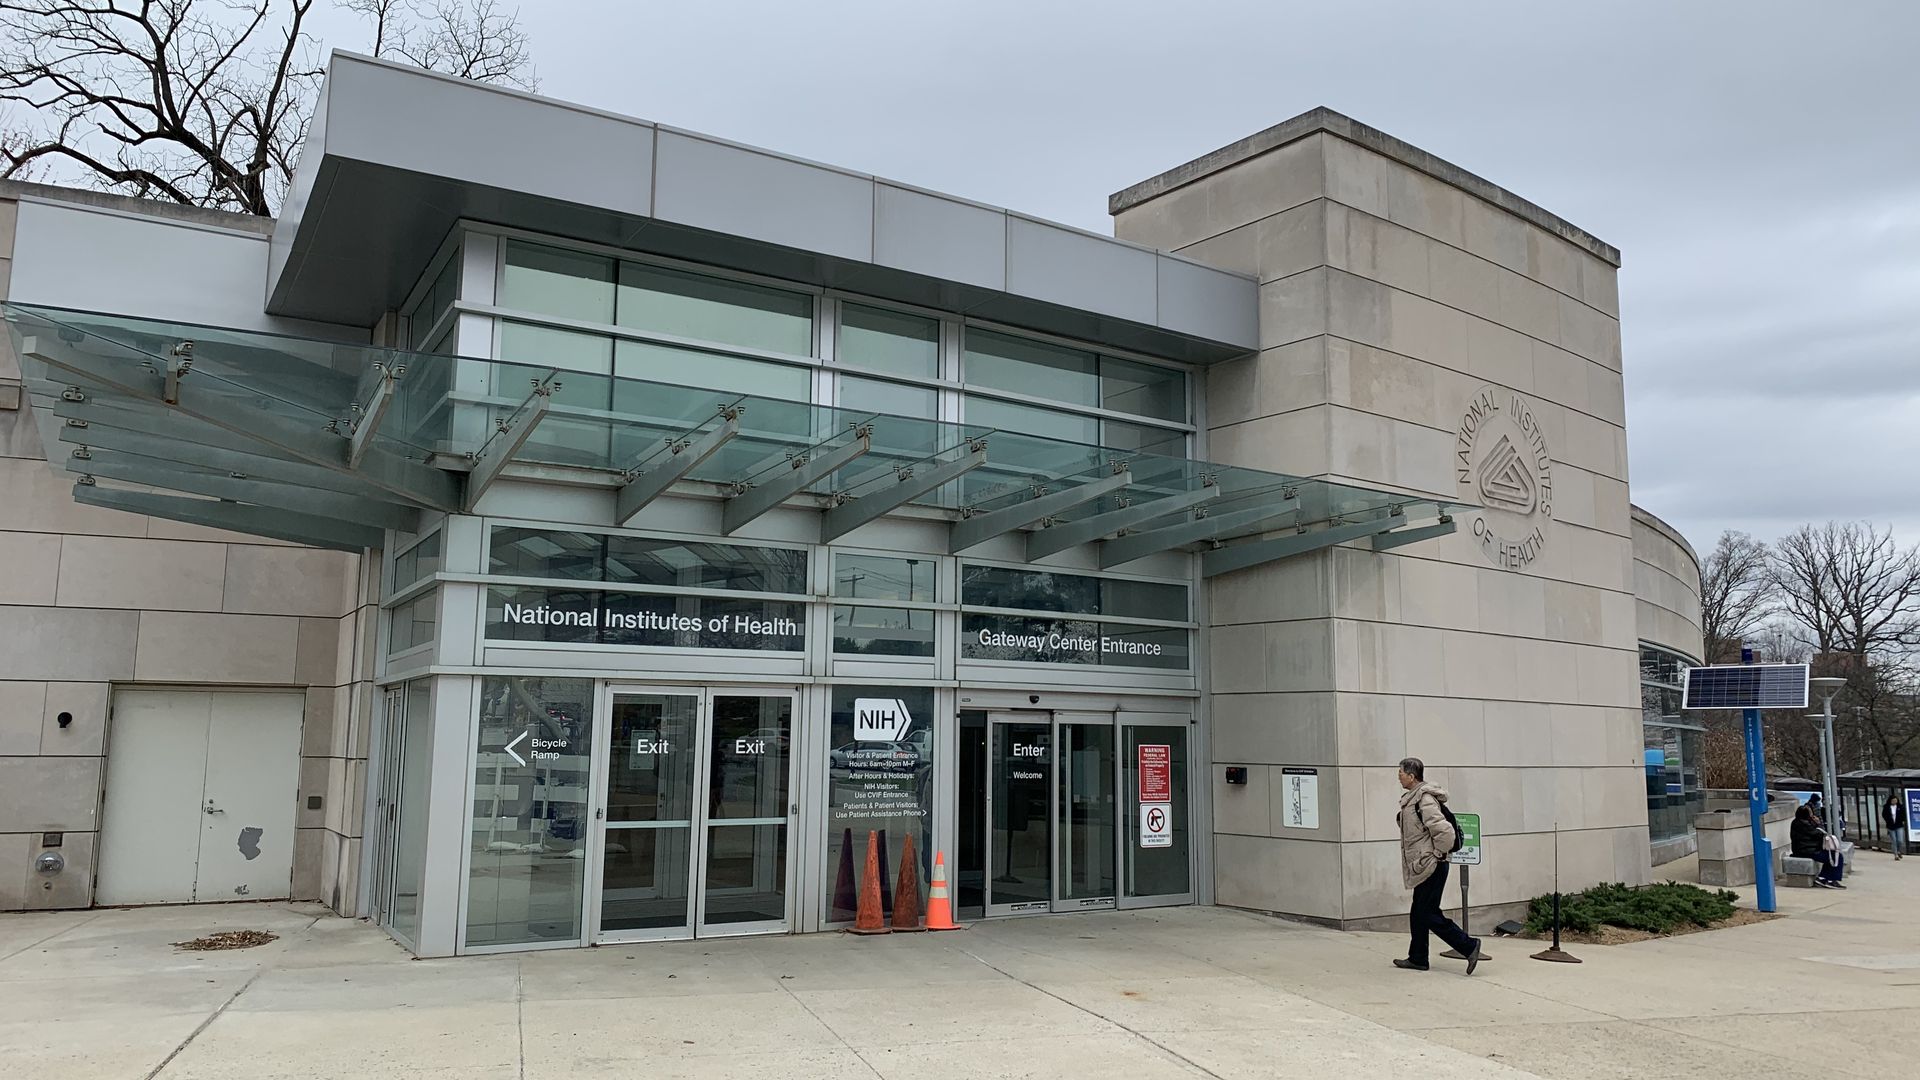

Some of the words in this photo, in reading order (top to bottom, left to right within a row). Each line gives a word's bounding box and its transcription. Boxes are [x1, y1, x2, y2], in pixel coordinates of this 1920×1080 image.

[1457, 390, 1499, 484] NATIONAL
[1510, 396, 1552, 517] INSTITUTES
[1474, 517, 1493, 547] OF
[1499, 527, 1544, 570] HEALTH
[503, 603, 598, 627] National
[605, 608, 702, 631] Institutes
[709, 615, 728, 633] of
[735, 615, 797, 636] Health
[979, 628, 1045, 652] Gateway
[1050, 633, 1097, 651] Center
[1101, 637, 1161, 655] Entrance
[860, 710, 895, 730] NIH
[531, 738, 567, 749] Bicycle
[637, 739, 669, 754] Exit
[735, 739, 765, 754] Exit
[1013, 743, 1045, 756] Enter
[530, 751, 560, 761] Ramp
[1013, 771, 1043, 779] Welcome
